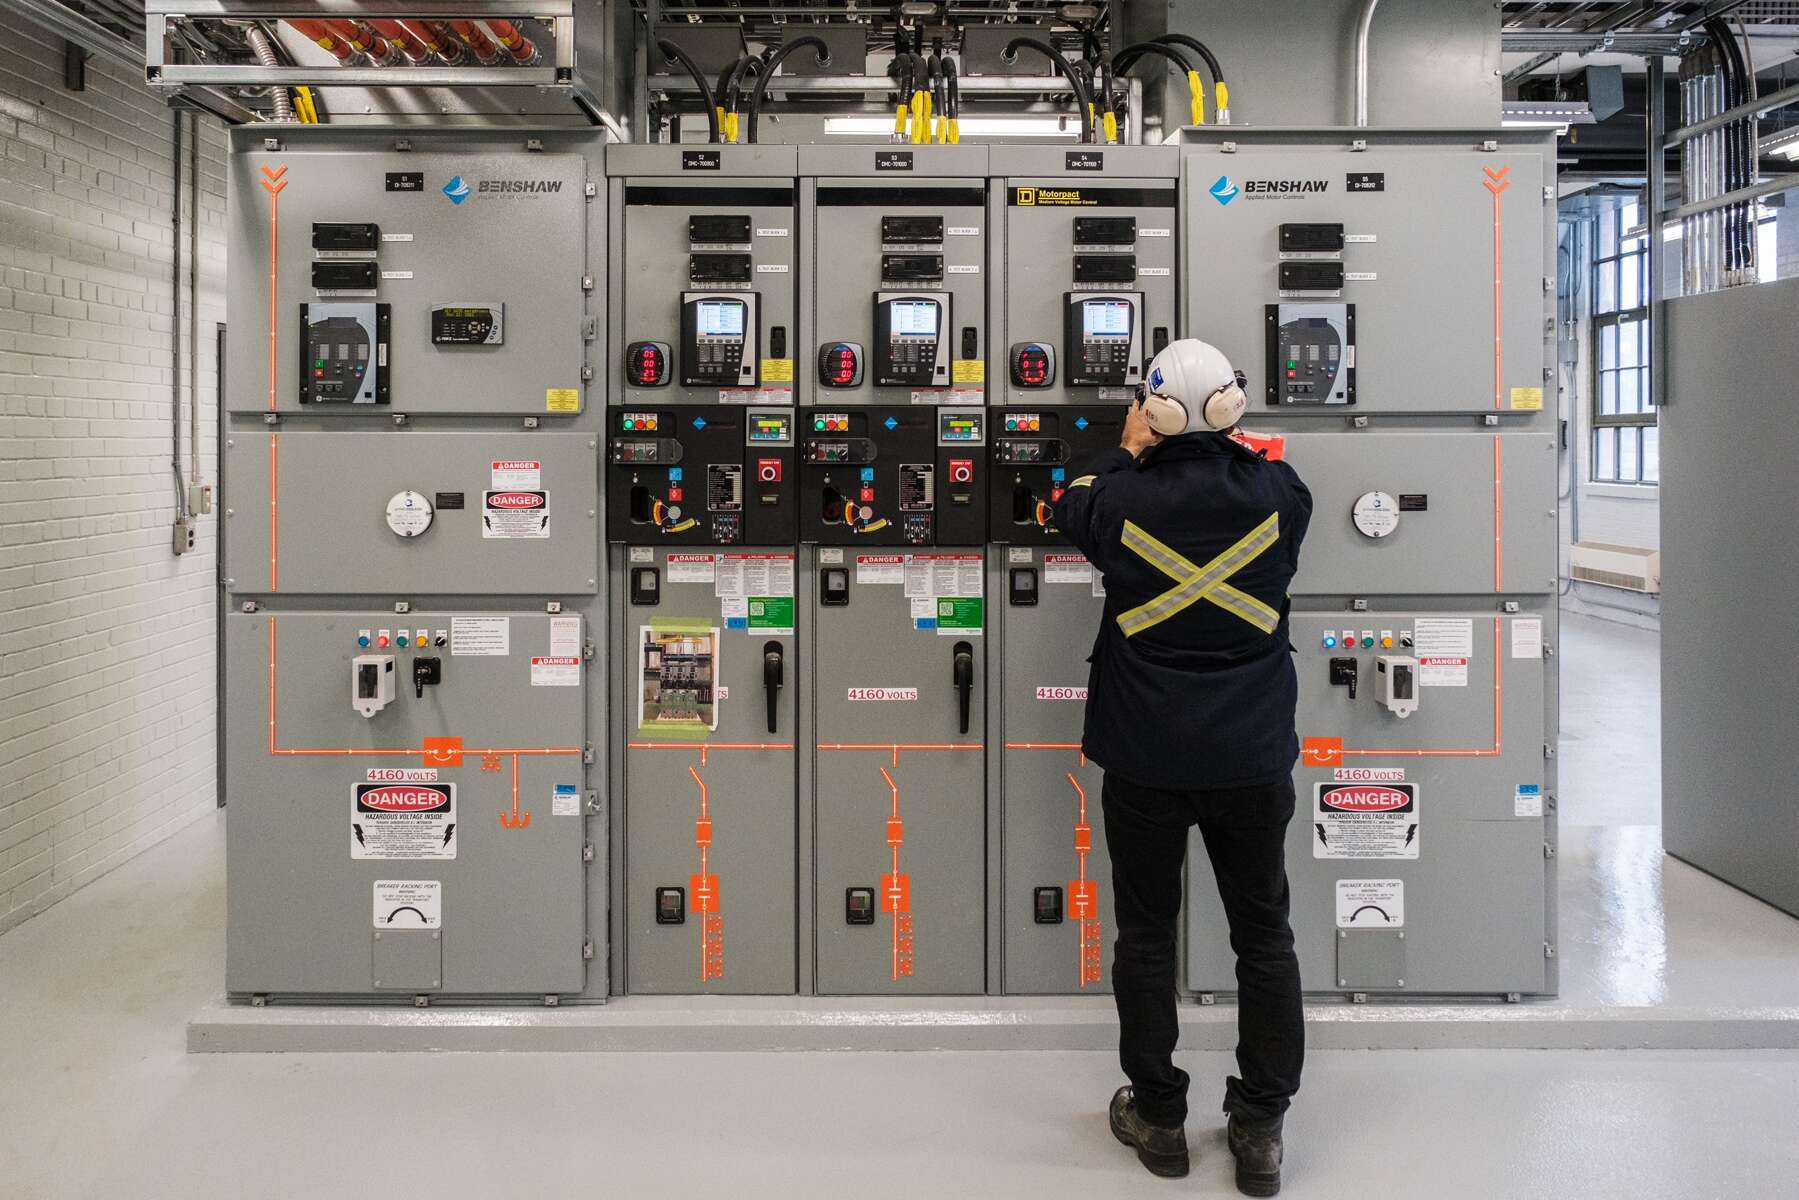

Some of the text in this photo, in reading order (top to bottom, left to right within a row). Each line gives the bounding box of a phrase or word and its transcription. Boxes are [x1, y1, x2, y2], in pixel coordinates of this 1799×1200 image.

[478, 181, 563, 192] BENSHAW
[1244, 181, 1328, 192] BENSHAW
[1039, 190, 1080, 199] Motorpact
[493, 496, 539, 505] DANGER
[849, 689, 916, 699] 4160 VOLTS
[1038, 688, 1088, 699] 4160 VO
[368, 770, 437, 780] 4160 VOLTS
[1335, 769, 1403, 780] 4160 VOLTS
[368, 792, 440, 805] DANGER
[1330, 792, 1402, 805] DANGER
